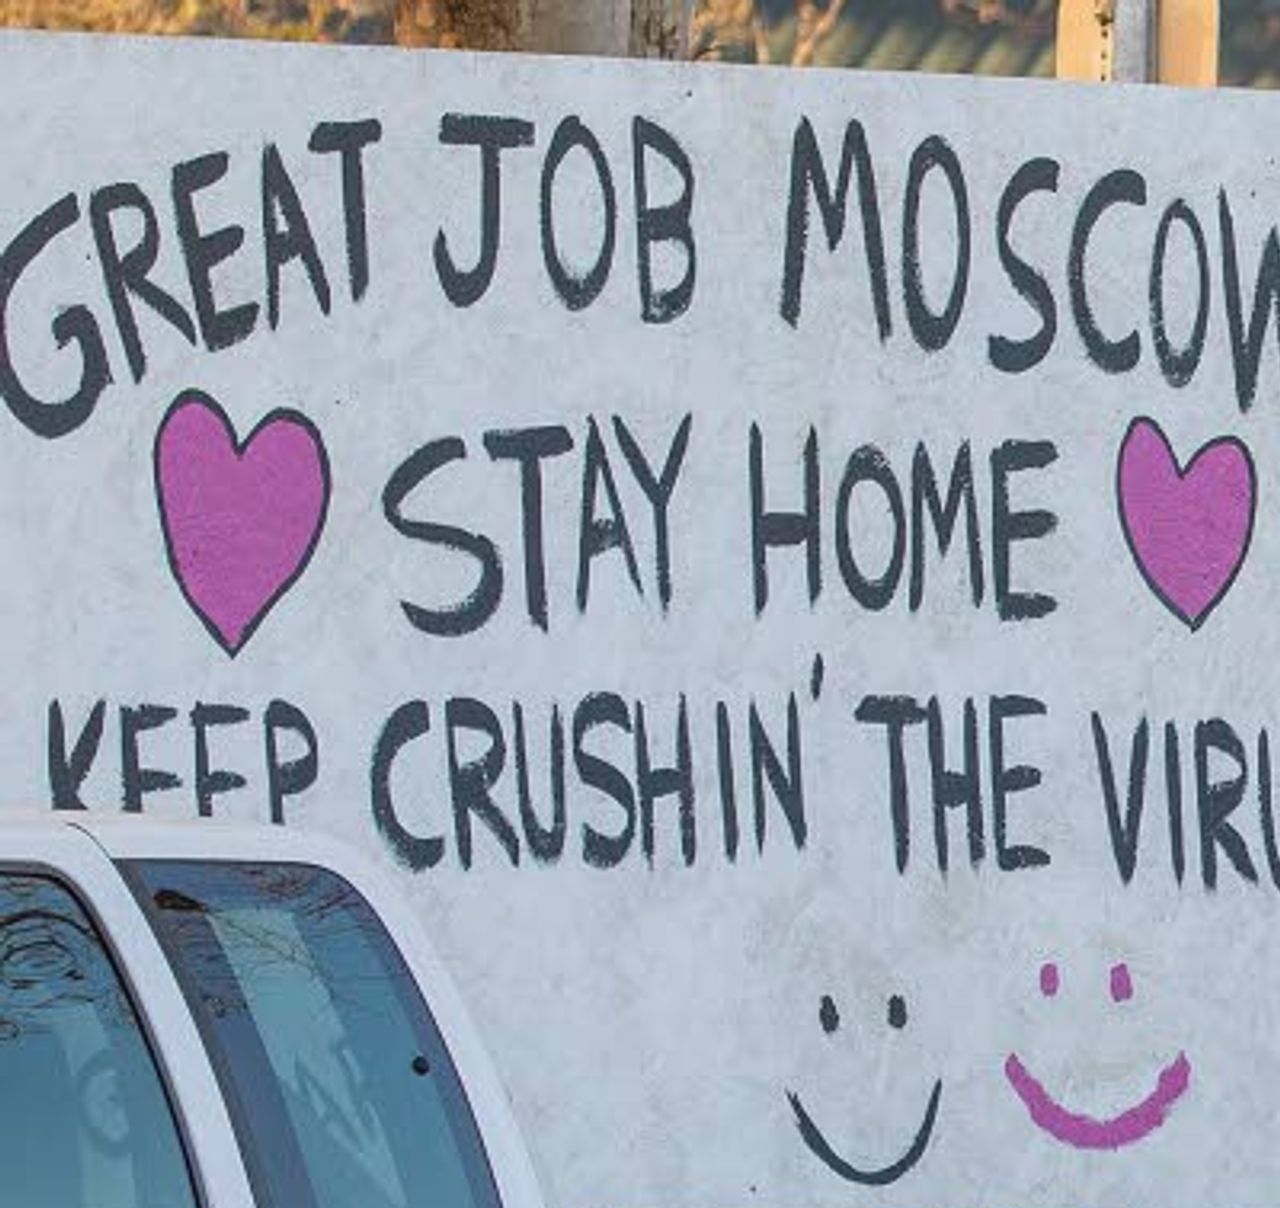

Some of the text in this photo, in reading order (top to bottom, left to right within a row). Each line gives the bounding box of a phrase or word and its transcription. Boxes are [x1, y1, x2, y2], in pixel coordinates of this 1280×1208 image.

[0, 118, 382, 439] GREAT
[434, 113, 696, 324] JOB
[381, 412, 1059, 636] STAY HOME
[371, 653, 824, 871] CRUSHIN'
[855, 695, 1052, 875] THE
